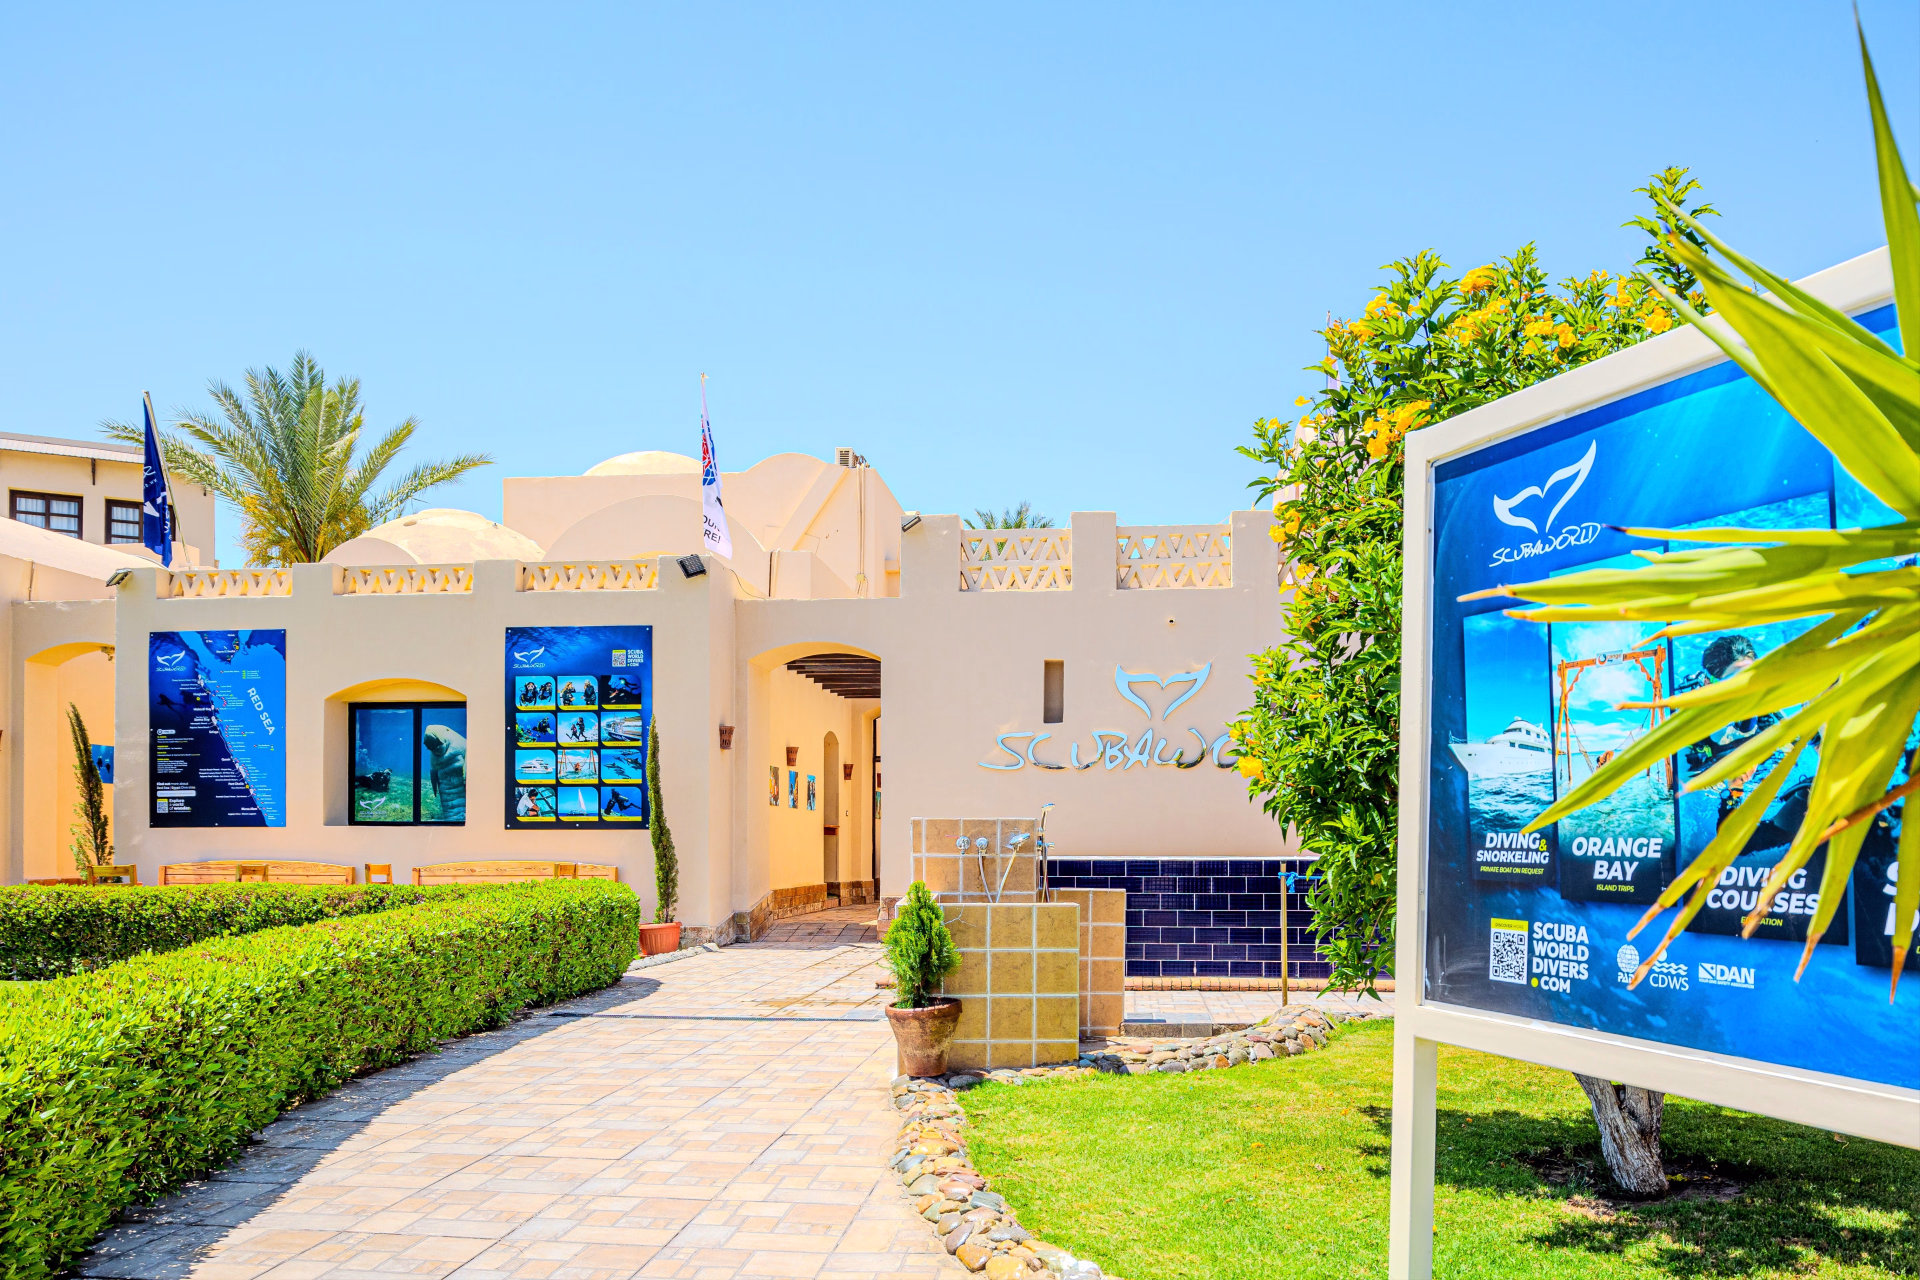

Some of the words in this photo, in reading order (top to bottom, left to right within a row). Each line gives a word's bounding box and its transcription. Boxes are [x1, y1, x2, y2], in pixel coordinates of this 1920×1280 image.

[1489, 522, 1601, 567] SCUBAWORLD
[247, 687, 264, 711] RED
[260, 711, 276, 736] SEA
[978, 727, 1243, 771] SCUBAWO
[1485, 832, 1541, 849] DIVING
[1571, 836, 1663, 858] ORANGE
[1476, 849, 1550, 864] SNORKELING
[1593, 860, 1639, 881] BAY
[1719, 866, 1808, 890] DIVIG
[1596, 884, 1617, 892] ISLAND
[1706, 889, 1821, 915] COUSES
[1741, 916, 1783, 926] EATION
[1532, 921, 1589, 944] SCUBA
[1532, 940, 1589, 961] WORLD
[1532, 956, 1589, 980] DIVERS
[1617, 971, 1636, 984] PAD
[1716, 964, 1755, 985] DAN
[1649, 973, 1689, 991] CDWS
